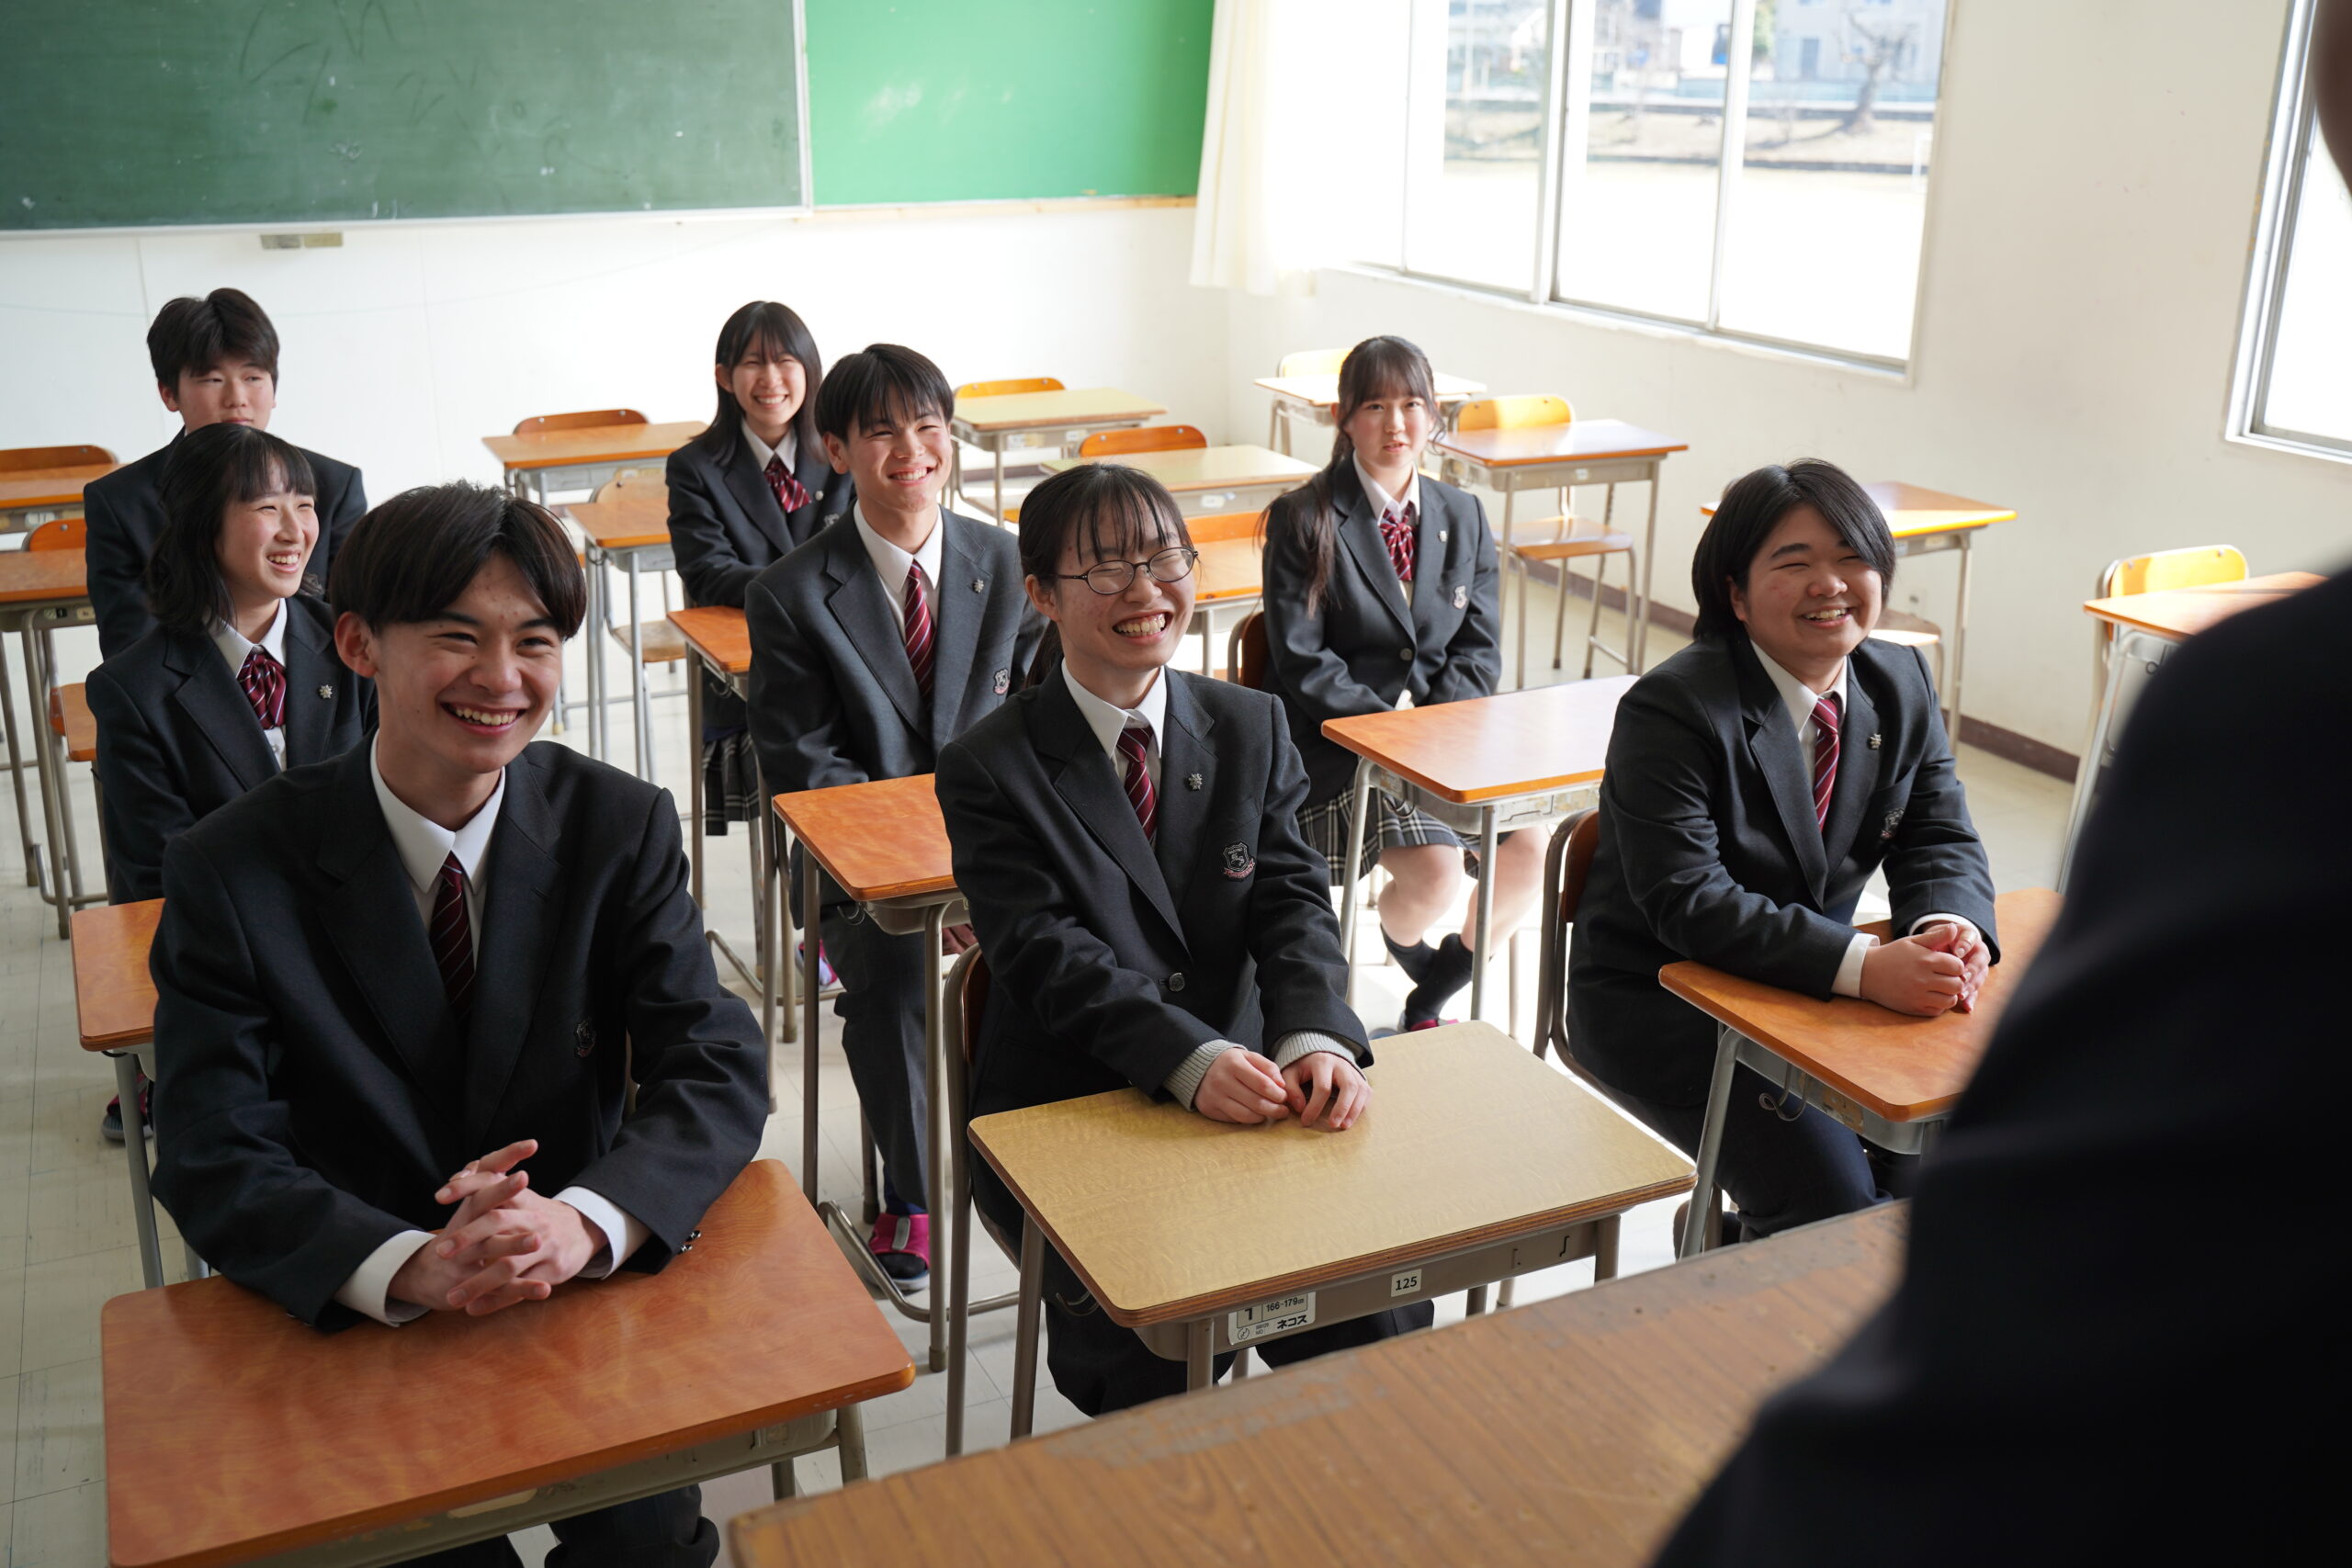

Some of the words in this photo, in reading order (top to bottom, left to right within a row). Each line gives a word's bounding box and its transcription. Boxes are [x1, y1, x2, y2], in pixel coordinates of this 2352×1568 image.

[1396, 1276, 1418, 1292] 125
[1276, 1314, 1307, 1330] ネコス
